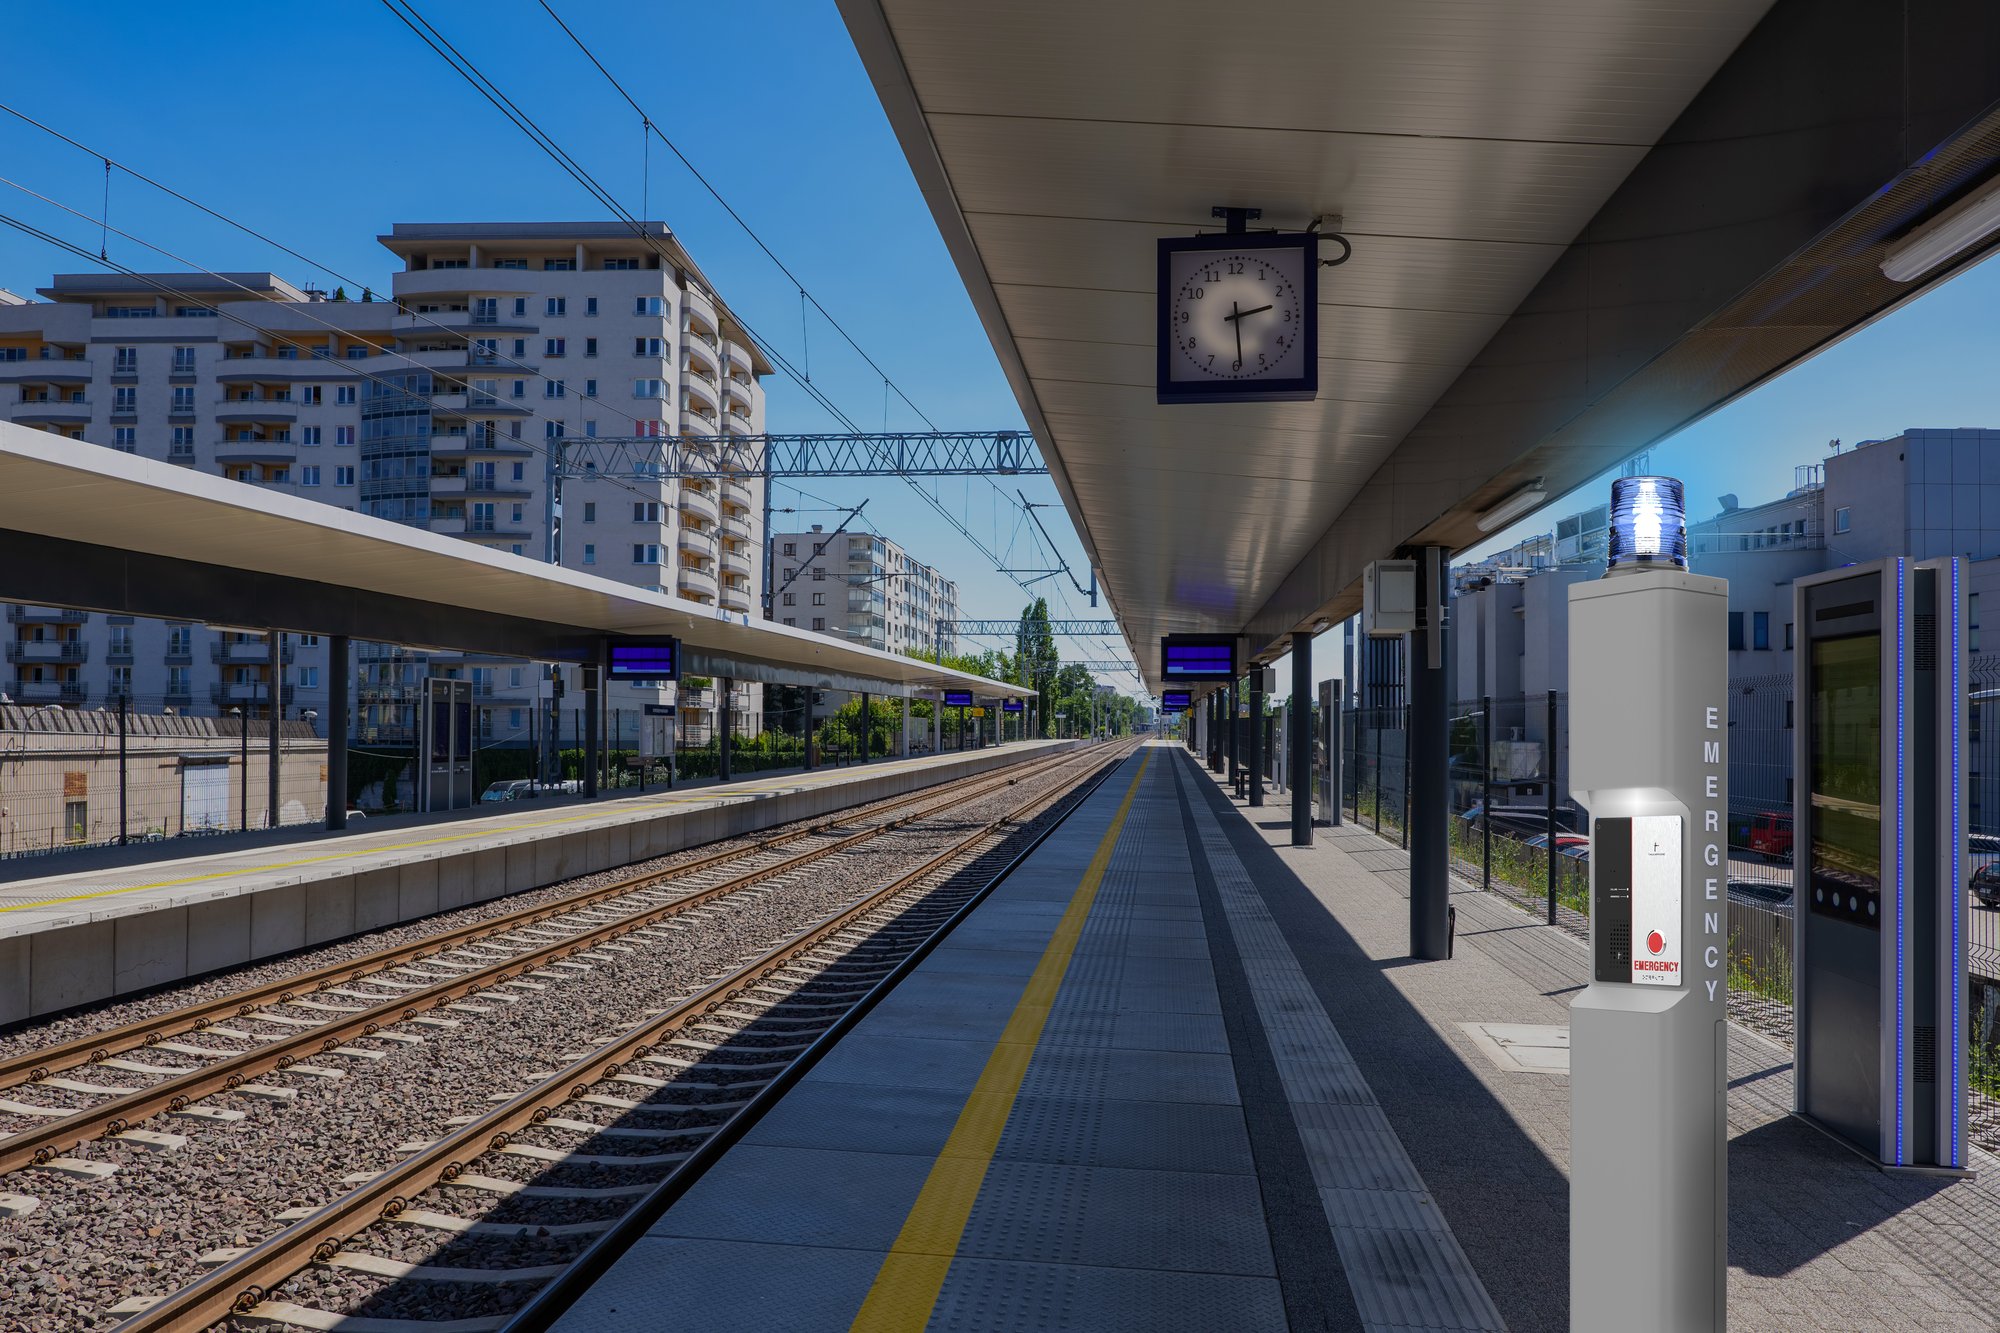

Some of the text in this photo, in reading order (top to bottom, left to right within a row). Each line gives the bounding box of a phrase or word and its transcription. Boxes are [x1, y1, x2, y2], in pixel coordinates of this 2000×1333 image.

[1228, 263, 1244, 275] 12
[1259, 269, 1266, 281] 1
[1205, 271, 1221, 283] 11
[1188, 288, 1204, 300] 10
[1275, 285, 1283, 297] 2
[1181, 312, 1190, 324] 9
[1284, 310, 1291, 322] 3
[1188, 337, 1196, 349] 8
[1276, 335, 1284, 346] 4
[1208, 355, 1215, 367] 7
[1232, 360, 1240, 372] 6
[1259, 354, 1265, 366] 5
[1704, 706, 1719, 1002] EMERGENCY
[1634, 960, 1679, 972] EMERGENCY
